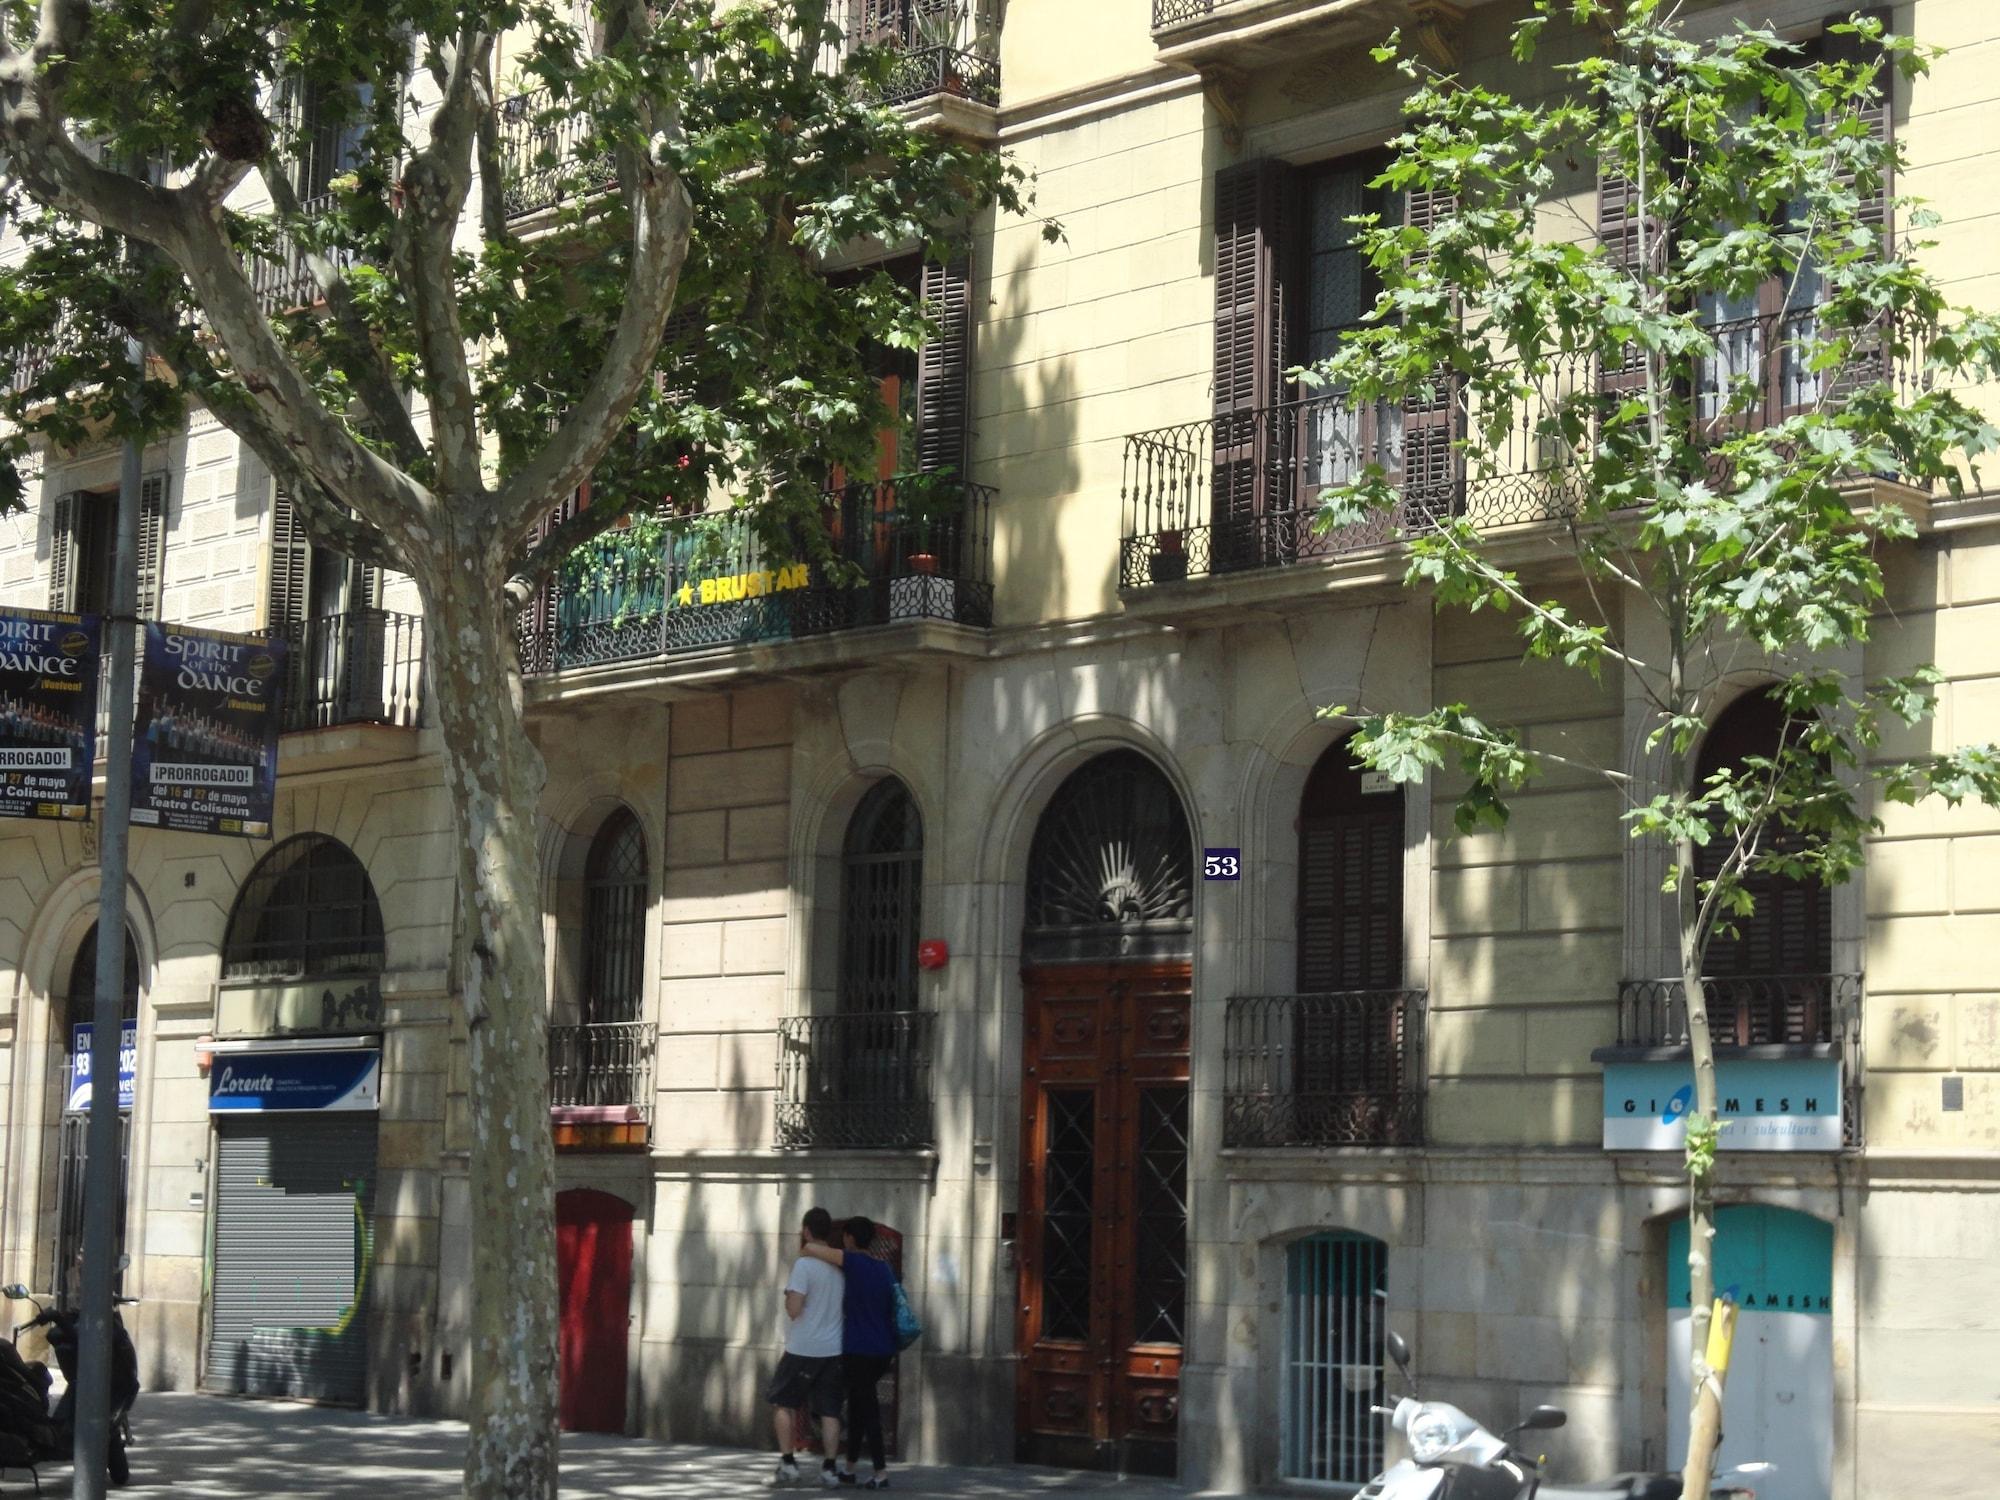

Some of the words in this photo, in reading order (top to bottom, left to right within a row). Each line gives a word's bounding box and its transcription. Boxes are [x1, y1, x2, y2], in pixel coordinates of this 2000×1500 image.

[700, 563, 809, 605] BRUSTAR
[208, 661, 231, 673] the
[0, 751, 67, 766] RROGADO!
[9, 773, 22, 785] 27
[24, 774, 36, 786] de
[39, 777, 66, 790] mayo
[155, 766, 249, 783] ¡PRORROGADO!
[6, 785, 68, 800] Coliseum
[153, 784, 167, 796] del
[183, 787, 192, 799] al
[208, 790, 219, 802] de
[222, 793, 248, 807] mayo
[191, 801, 249, 817] Coliseum
[1205, 856, 1238, 876] 53
[77, 1032, 91, 1051] EN
[76, 1052, 90, 1076] 93
[213, 1065, 274, 1097] Lorente
[1624, 1098, 1817, 1113] GIGMESH
